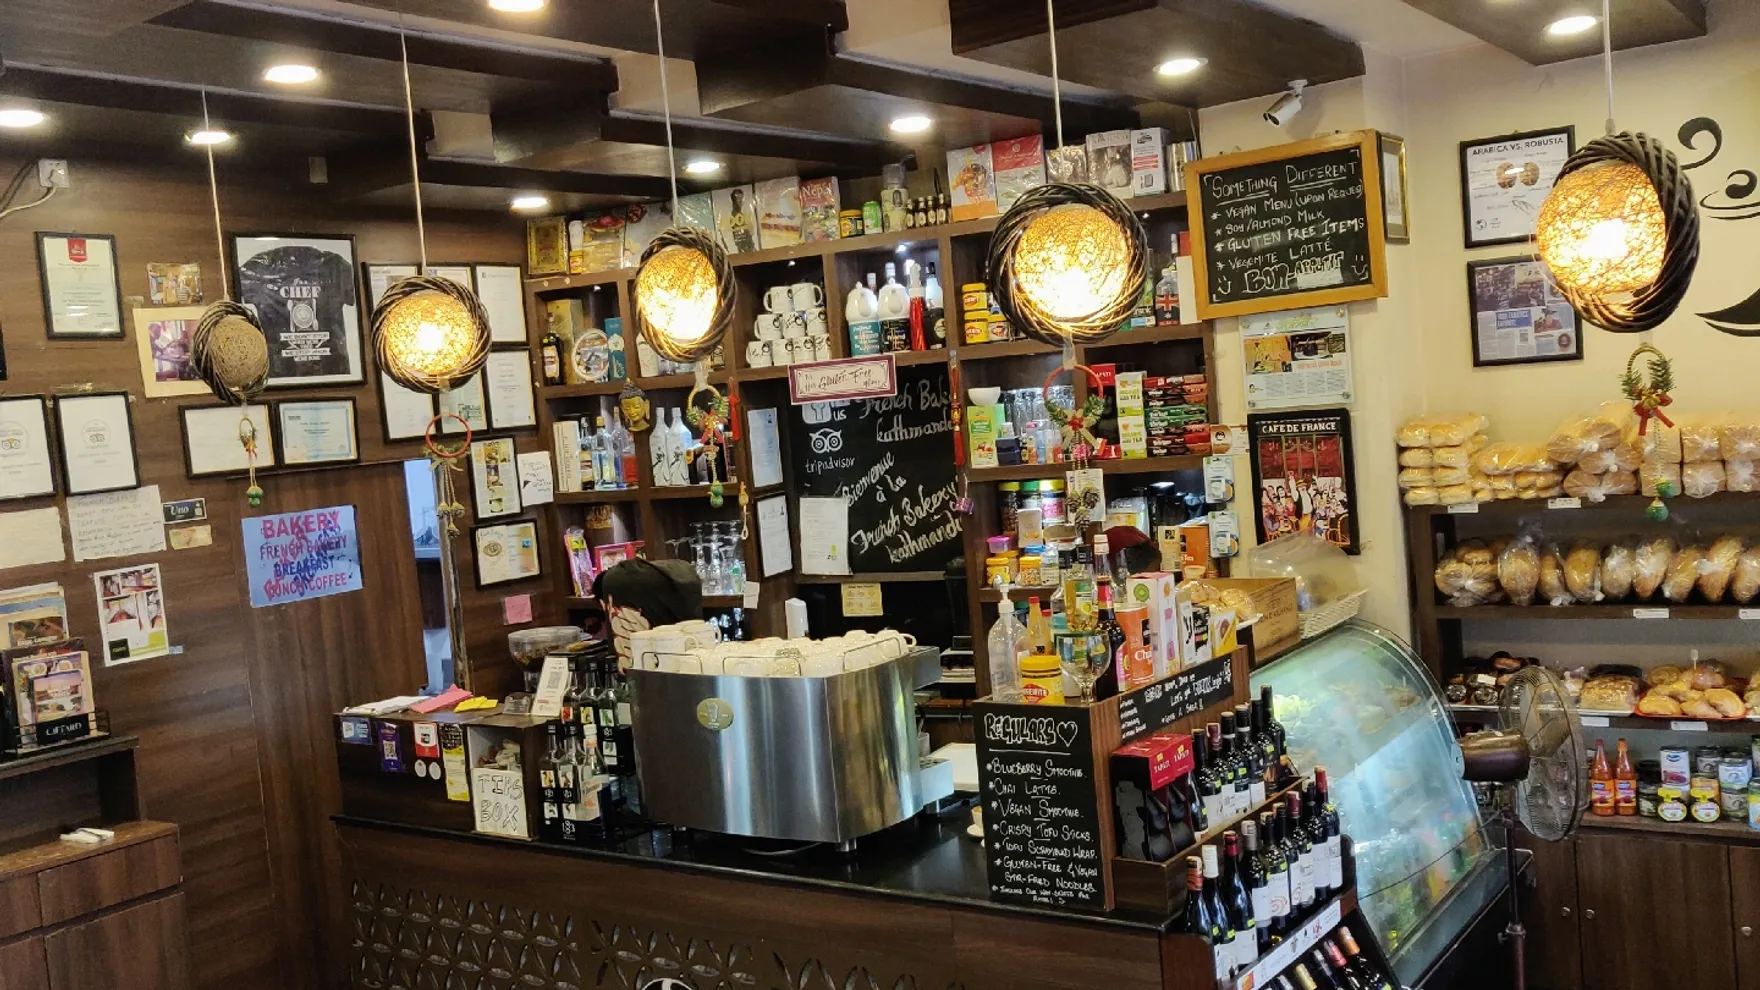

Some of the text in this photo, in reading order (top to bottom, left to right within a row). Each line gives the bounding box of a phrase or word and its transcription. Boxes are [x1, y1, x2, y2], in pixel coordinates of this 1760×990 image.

[1472, 146, 1508, 156] ARABICA
[1525, 138, 1564, 148] ROBUSTA
[1212, 162, 1358, 198] SOMETHING DIFFERENT
[1225, 204, 1256, 218] VEGAN
[1264, 198, 1293, 212] MENU
[1298, 210, 1324, 225] MILK
[1228, 218, 1364, 251] GLUTEN FREE ITEMS
[280, 286, 321, 298] CHEF
[1262, 422, 1336, 434] CAFE DE FRANCE
[805, 456, 856, 474] tripadvisor
[842, 451, 894, 506] Bienvenue
[262, 511, 340, 539] BAKERY
[260, 535, 347, 560] FRENCH BAKERY
[274, 555, 334, 577] BREAKFAST
[308, 572, 348, 592] COFFEE
[984, 712, 1056, 746] REGULARS
[992, 757, 1042, 774] BLUEBERRY
[478, 774, 522, 800] TIPS
[994, 778, 1016, 795] CHAI
[480, 800, 520, 832] BOX
[998, 799, 1032, 817] VEGAN
[1000, 820, 1032, 838] CRISPY
[1036, 822, 1058, 838] TOFU
[1002, 837, 1023, 852] TOFU
[1074, 864, 1098, 877] VEGAN
